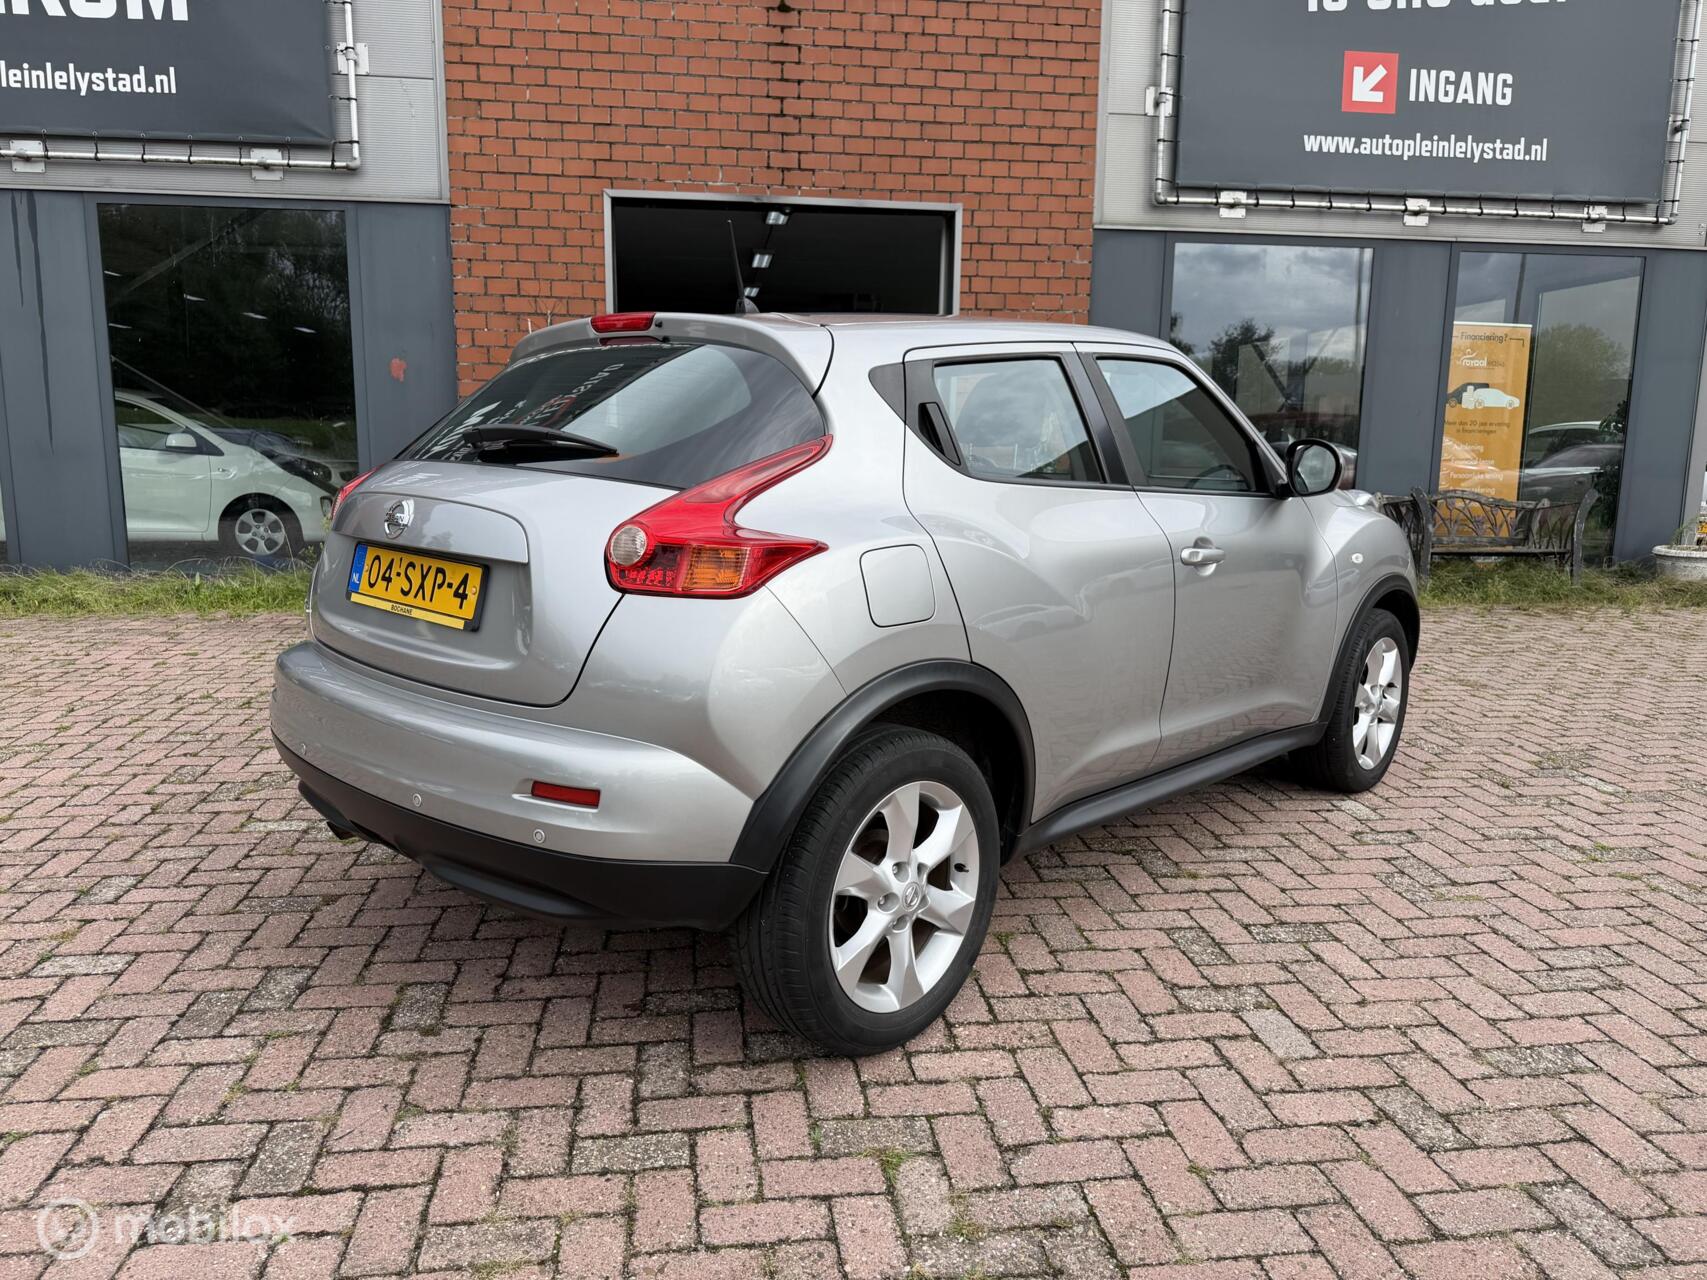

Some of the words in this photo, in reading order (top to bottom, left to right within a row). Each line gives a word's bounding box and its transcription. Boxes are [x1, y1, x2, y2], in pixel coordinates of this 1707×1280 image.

[1409, 68, 1513, 106] INGANG
[1303, 132, 1548, 163] www.autopleinlelystad.nl
[1460, 331, 1508, 344] Financiering?
[352, 573, 360, 583] NL
[367, 555, 470, 610] 04-SXP-4
[391, 604, 413, 615] BOCHANE
